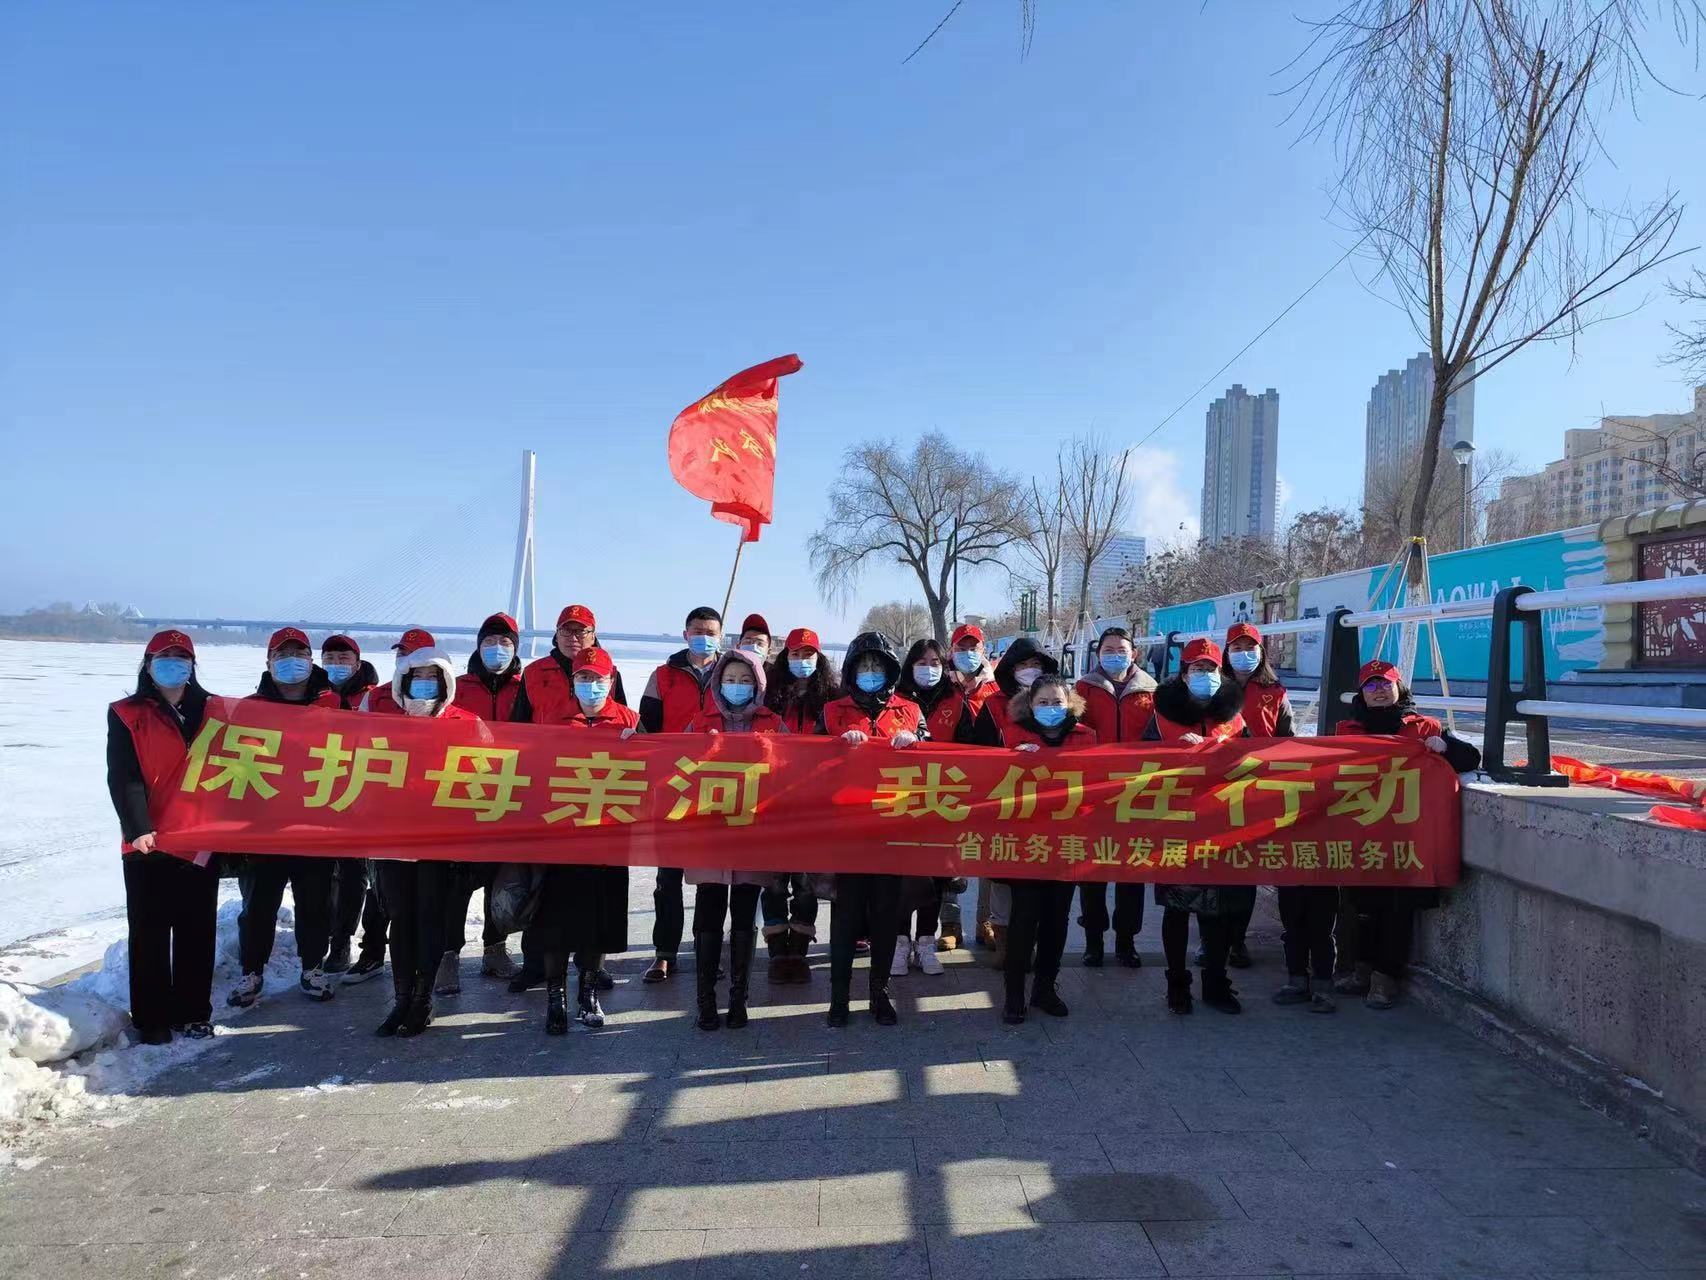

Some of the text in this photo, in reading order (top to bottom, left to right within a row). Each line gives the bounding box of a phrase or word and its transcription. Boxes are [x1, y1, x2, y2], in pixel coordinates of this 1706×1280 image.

[180, 717, 1422, 828] 保护母亲河 我们在行动
